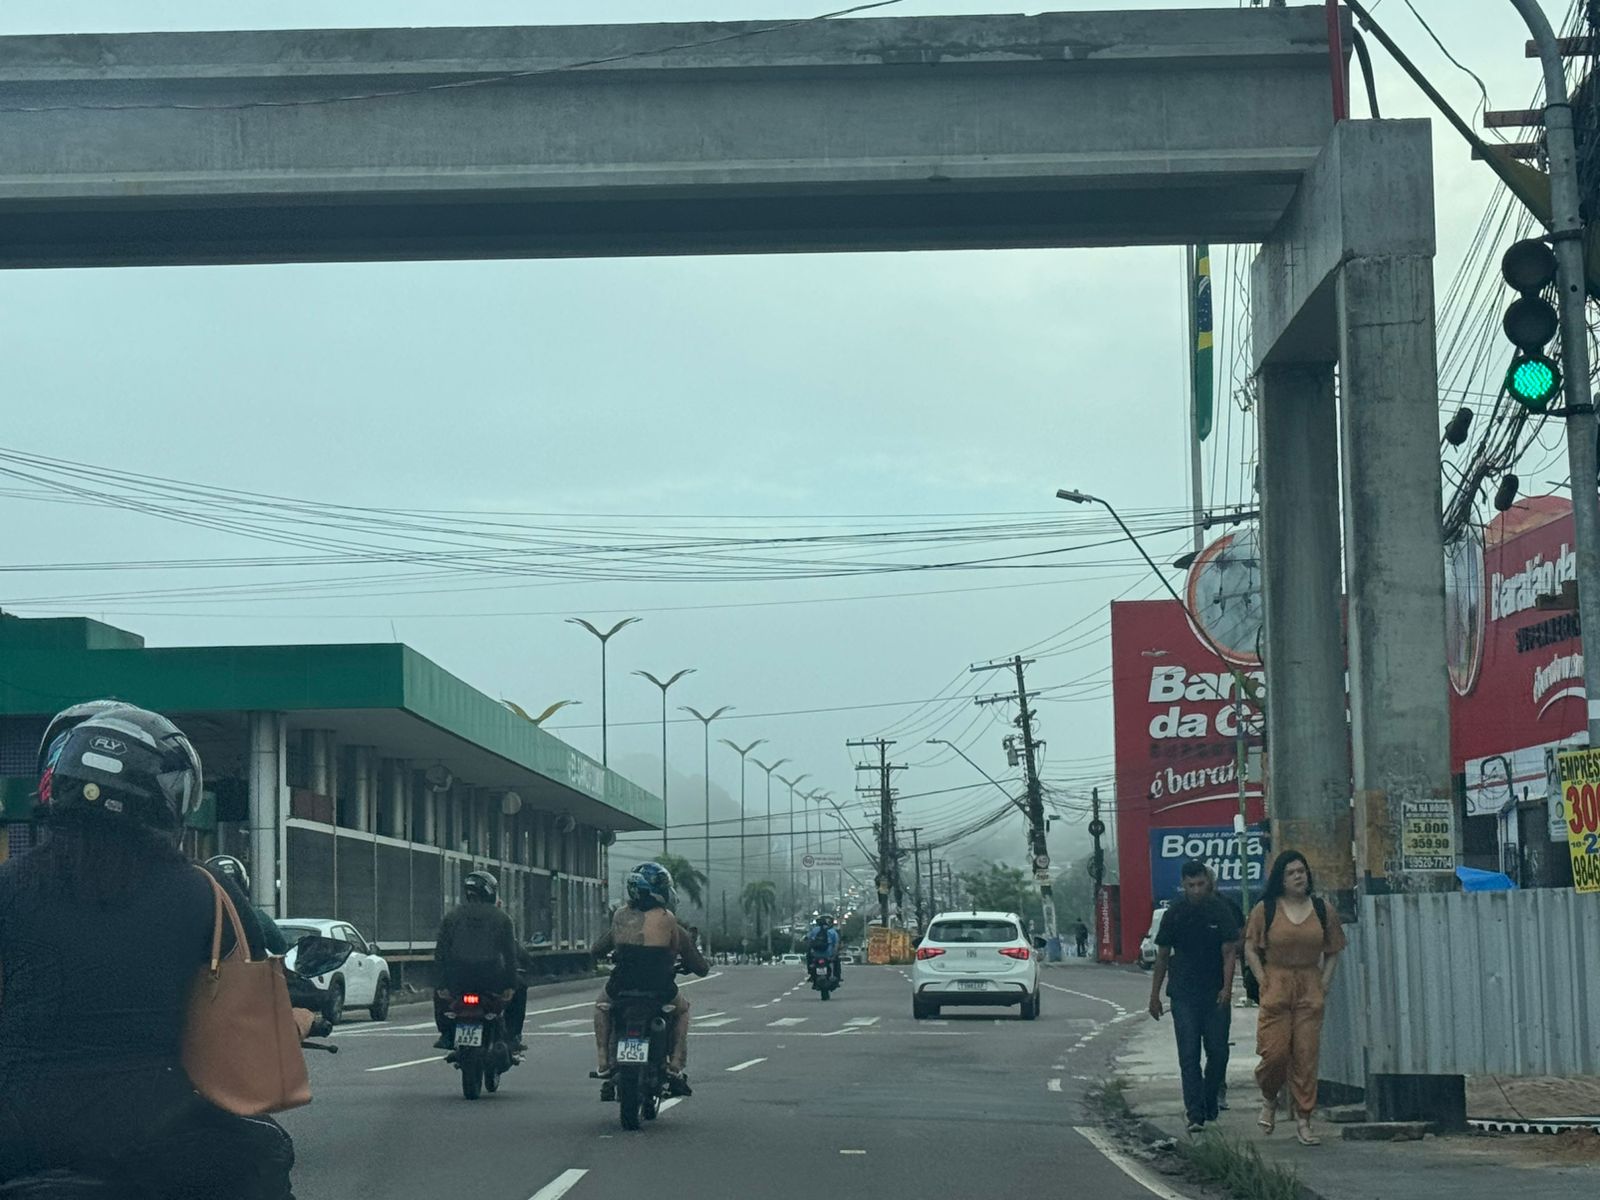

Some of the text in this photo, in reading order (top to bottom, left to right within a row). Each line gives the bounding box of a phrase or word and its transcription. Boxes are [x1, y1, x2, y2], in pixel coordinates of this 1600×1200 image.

[1149, 706, 1208, 738] da
[94, 738, 122, 750] FLY
[1566, 783, 1600, 834] 30
